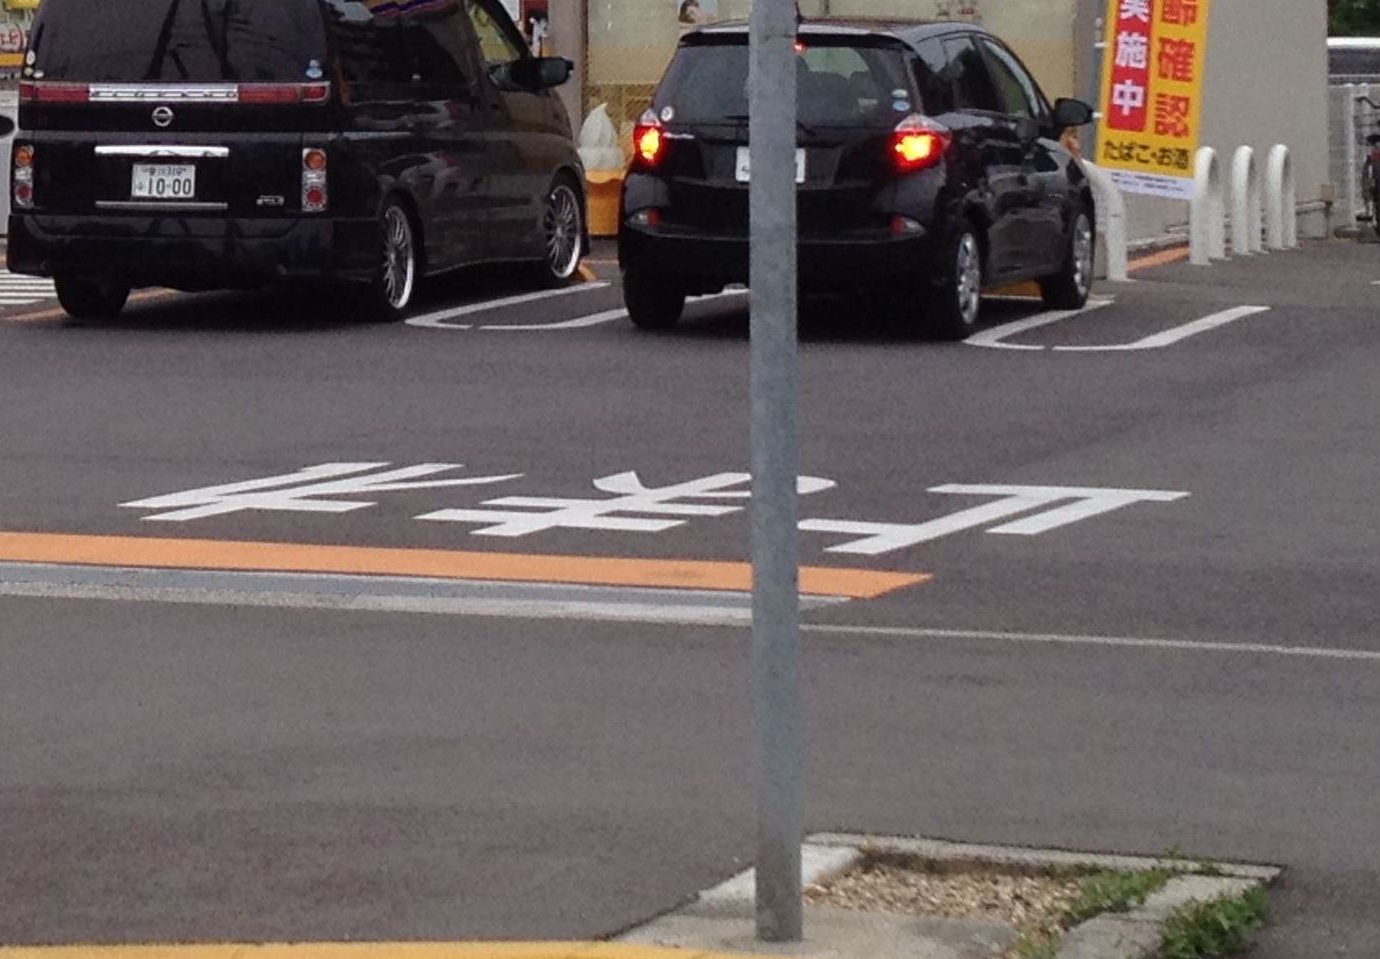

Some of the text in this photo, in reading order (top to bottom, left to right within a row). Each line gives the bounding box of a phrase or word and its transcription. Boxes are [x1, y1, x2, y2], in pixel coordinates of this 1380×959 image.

[1103, 140, 1190, 169] たばこ・お酒
[119, 462, 1190, 554] 止まれ
